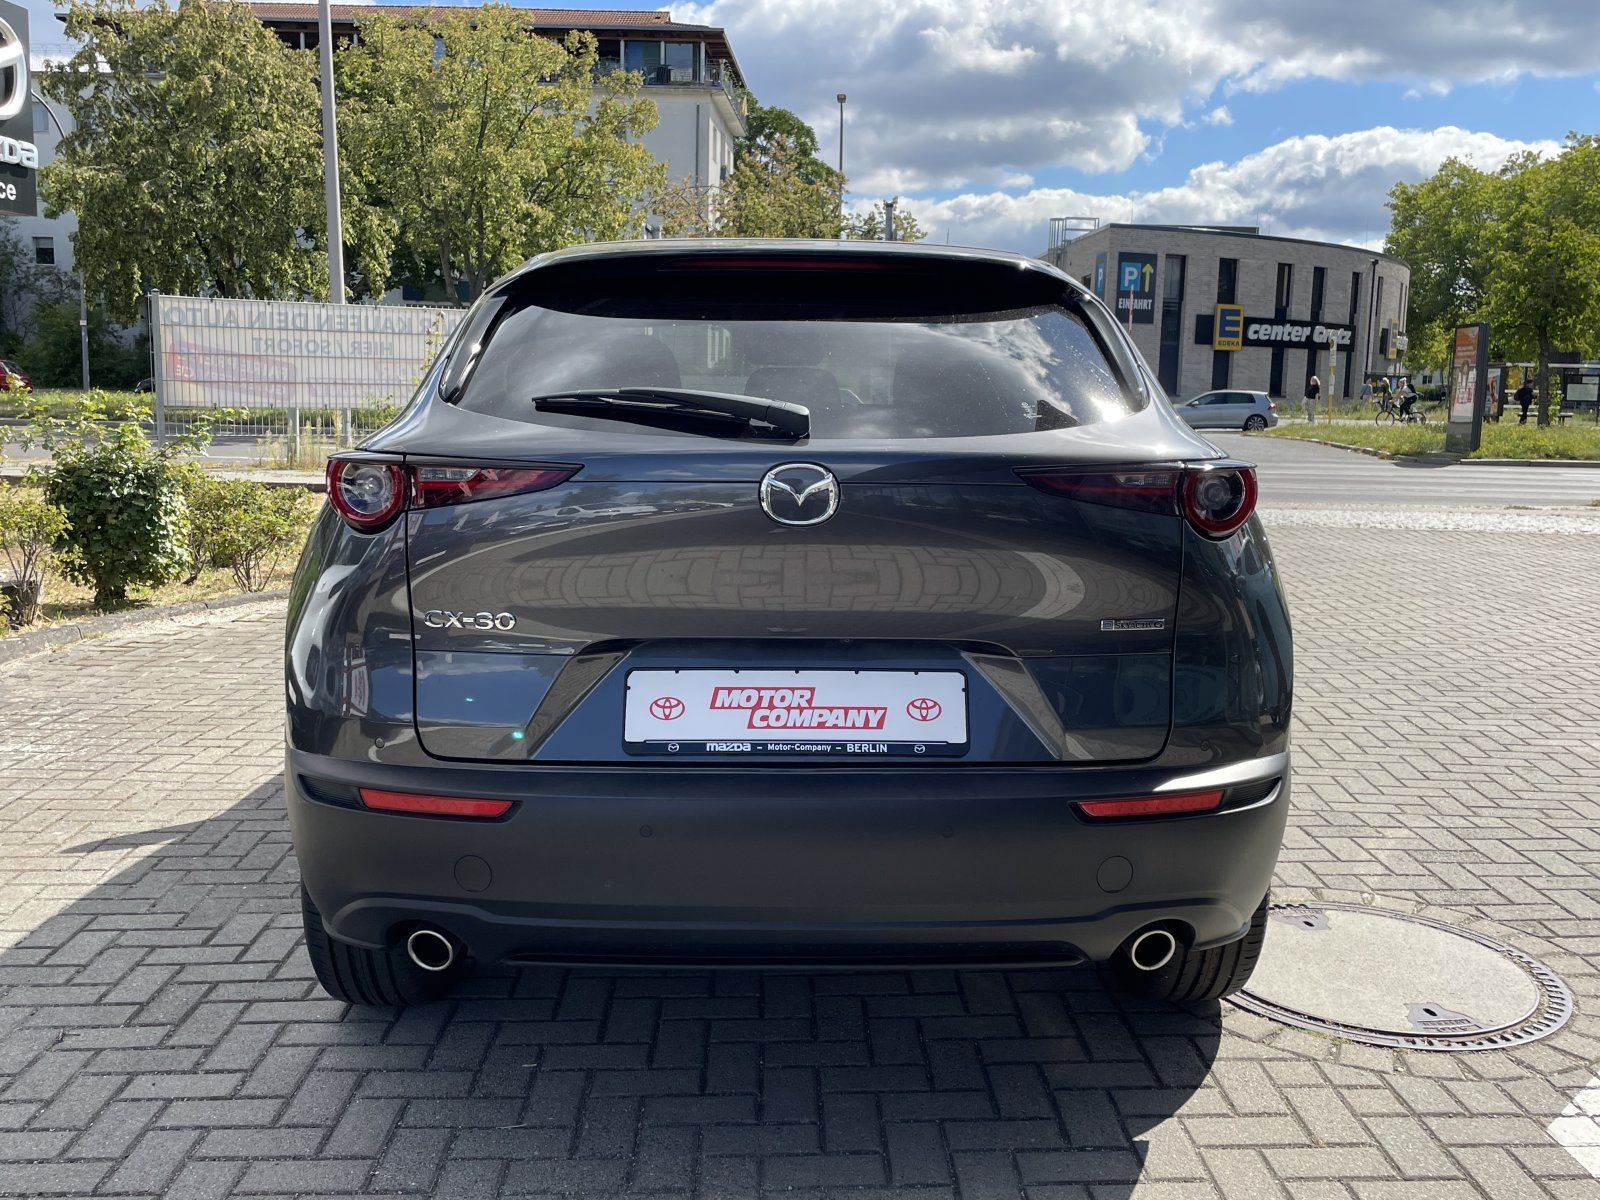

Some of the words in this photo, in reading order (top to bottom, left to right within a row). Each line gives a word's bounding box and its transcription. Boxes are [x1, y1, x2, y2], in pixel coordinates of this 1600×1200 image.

[0, 135, 38, 169] da
[1125, 267, 1138, 287] P
[1118, 298, 1152, 310] EINAHRT
[1248, 323, 1311, 342] center
[424, 609, 516, 631] CX-30
[714, 689, 811, 708] MOTOR
[752, 709, 886, 728] COMPANY
[706, 742, 751, 752] mazda
[847, 743, 888, 753] BERLIN
